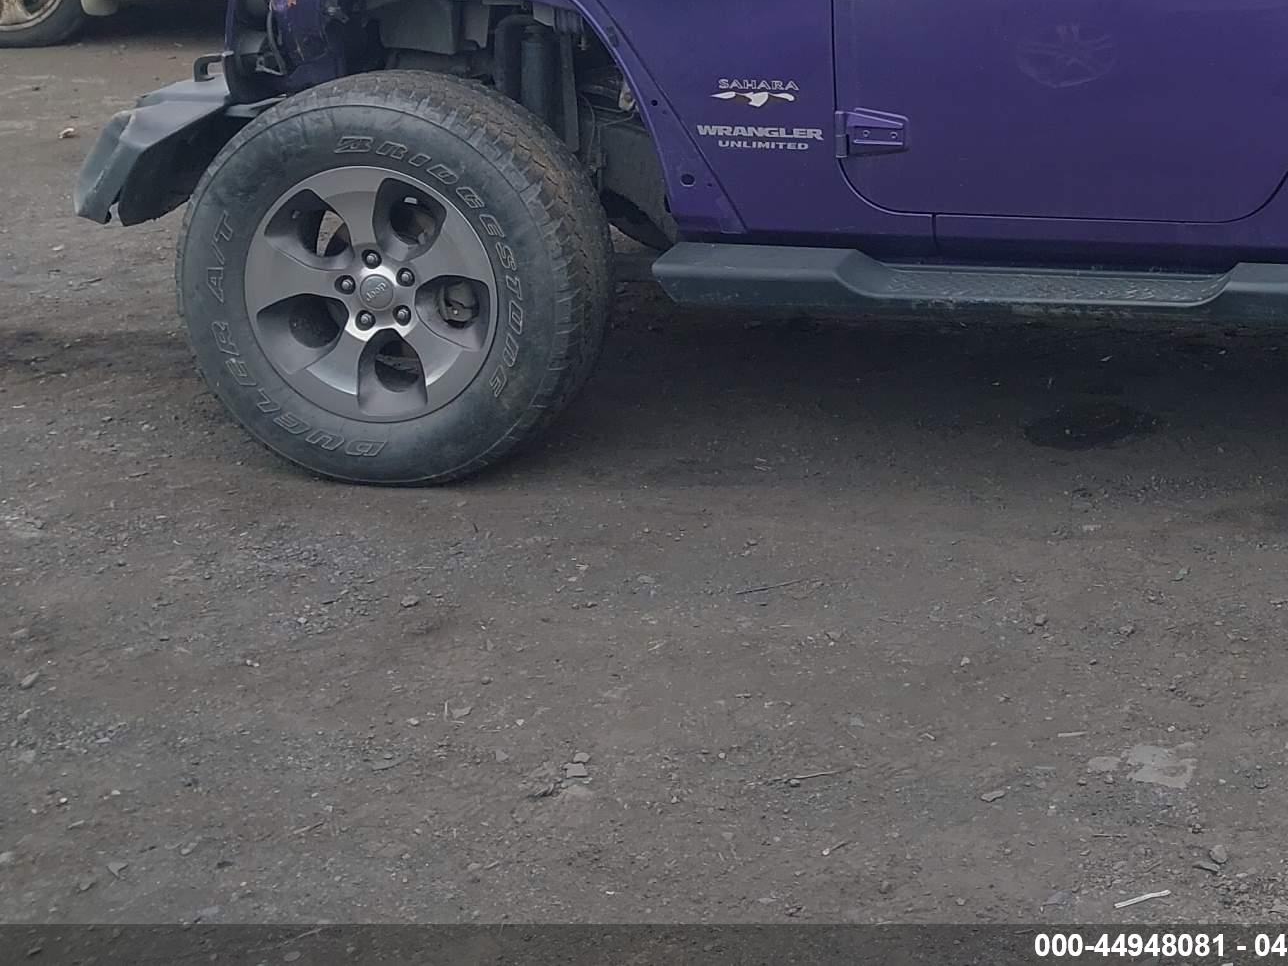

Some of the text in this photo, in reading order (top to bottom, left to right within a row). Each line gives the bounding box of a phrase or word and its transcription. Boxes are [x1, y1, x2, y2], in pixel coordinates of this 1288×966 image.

[718, 78, 800, 91] SAHARA
[696, 124, 824, 141] WRANGLER
[718, 140, 809, 150] UNLIMITED
[333, 135, 524, 398] BRIDGESTONE
[207, 210, 389, 458] DUELER A/T
